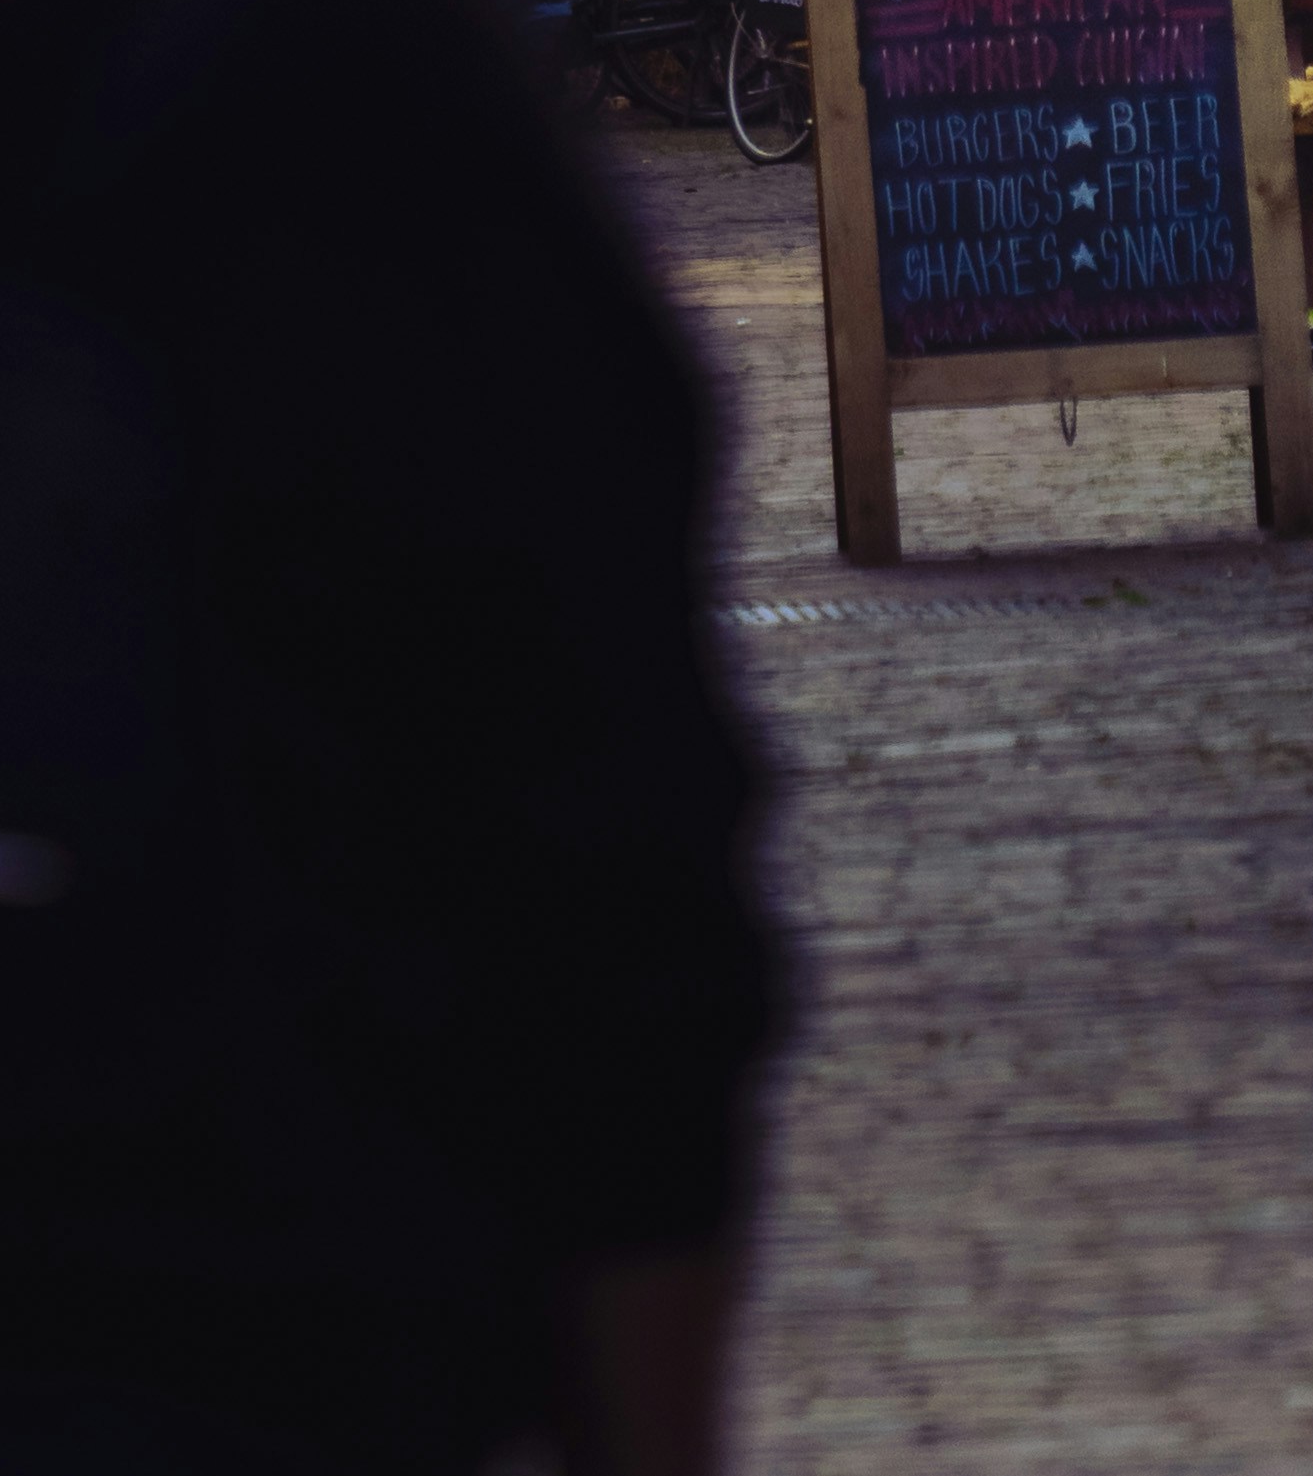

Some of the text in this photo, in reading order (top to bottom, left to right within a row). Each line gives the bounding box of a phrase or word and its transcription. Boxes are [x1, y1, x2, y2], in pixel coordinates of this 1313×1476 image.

[895, 93, 1221, 168] BURGERS BEER
[1105, 152, 1222, 221] FRIES
[901, 215, 1235, 302] SHAKES SNACKS
